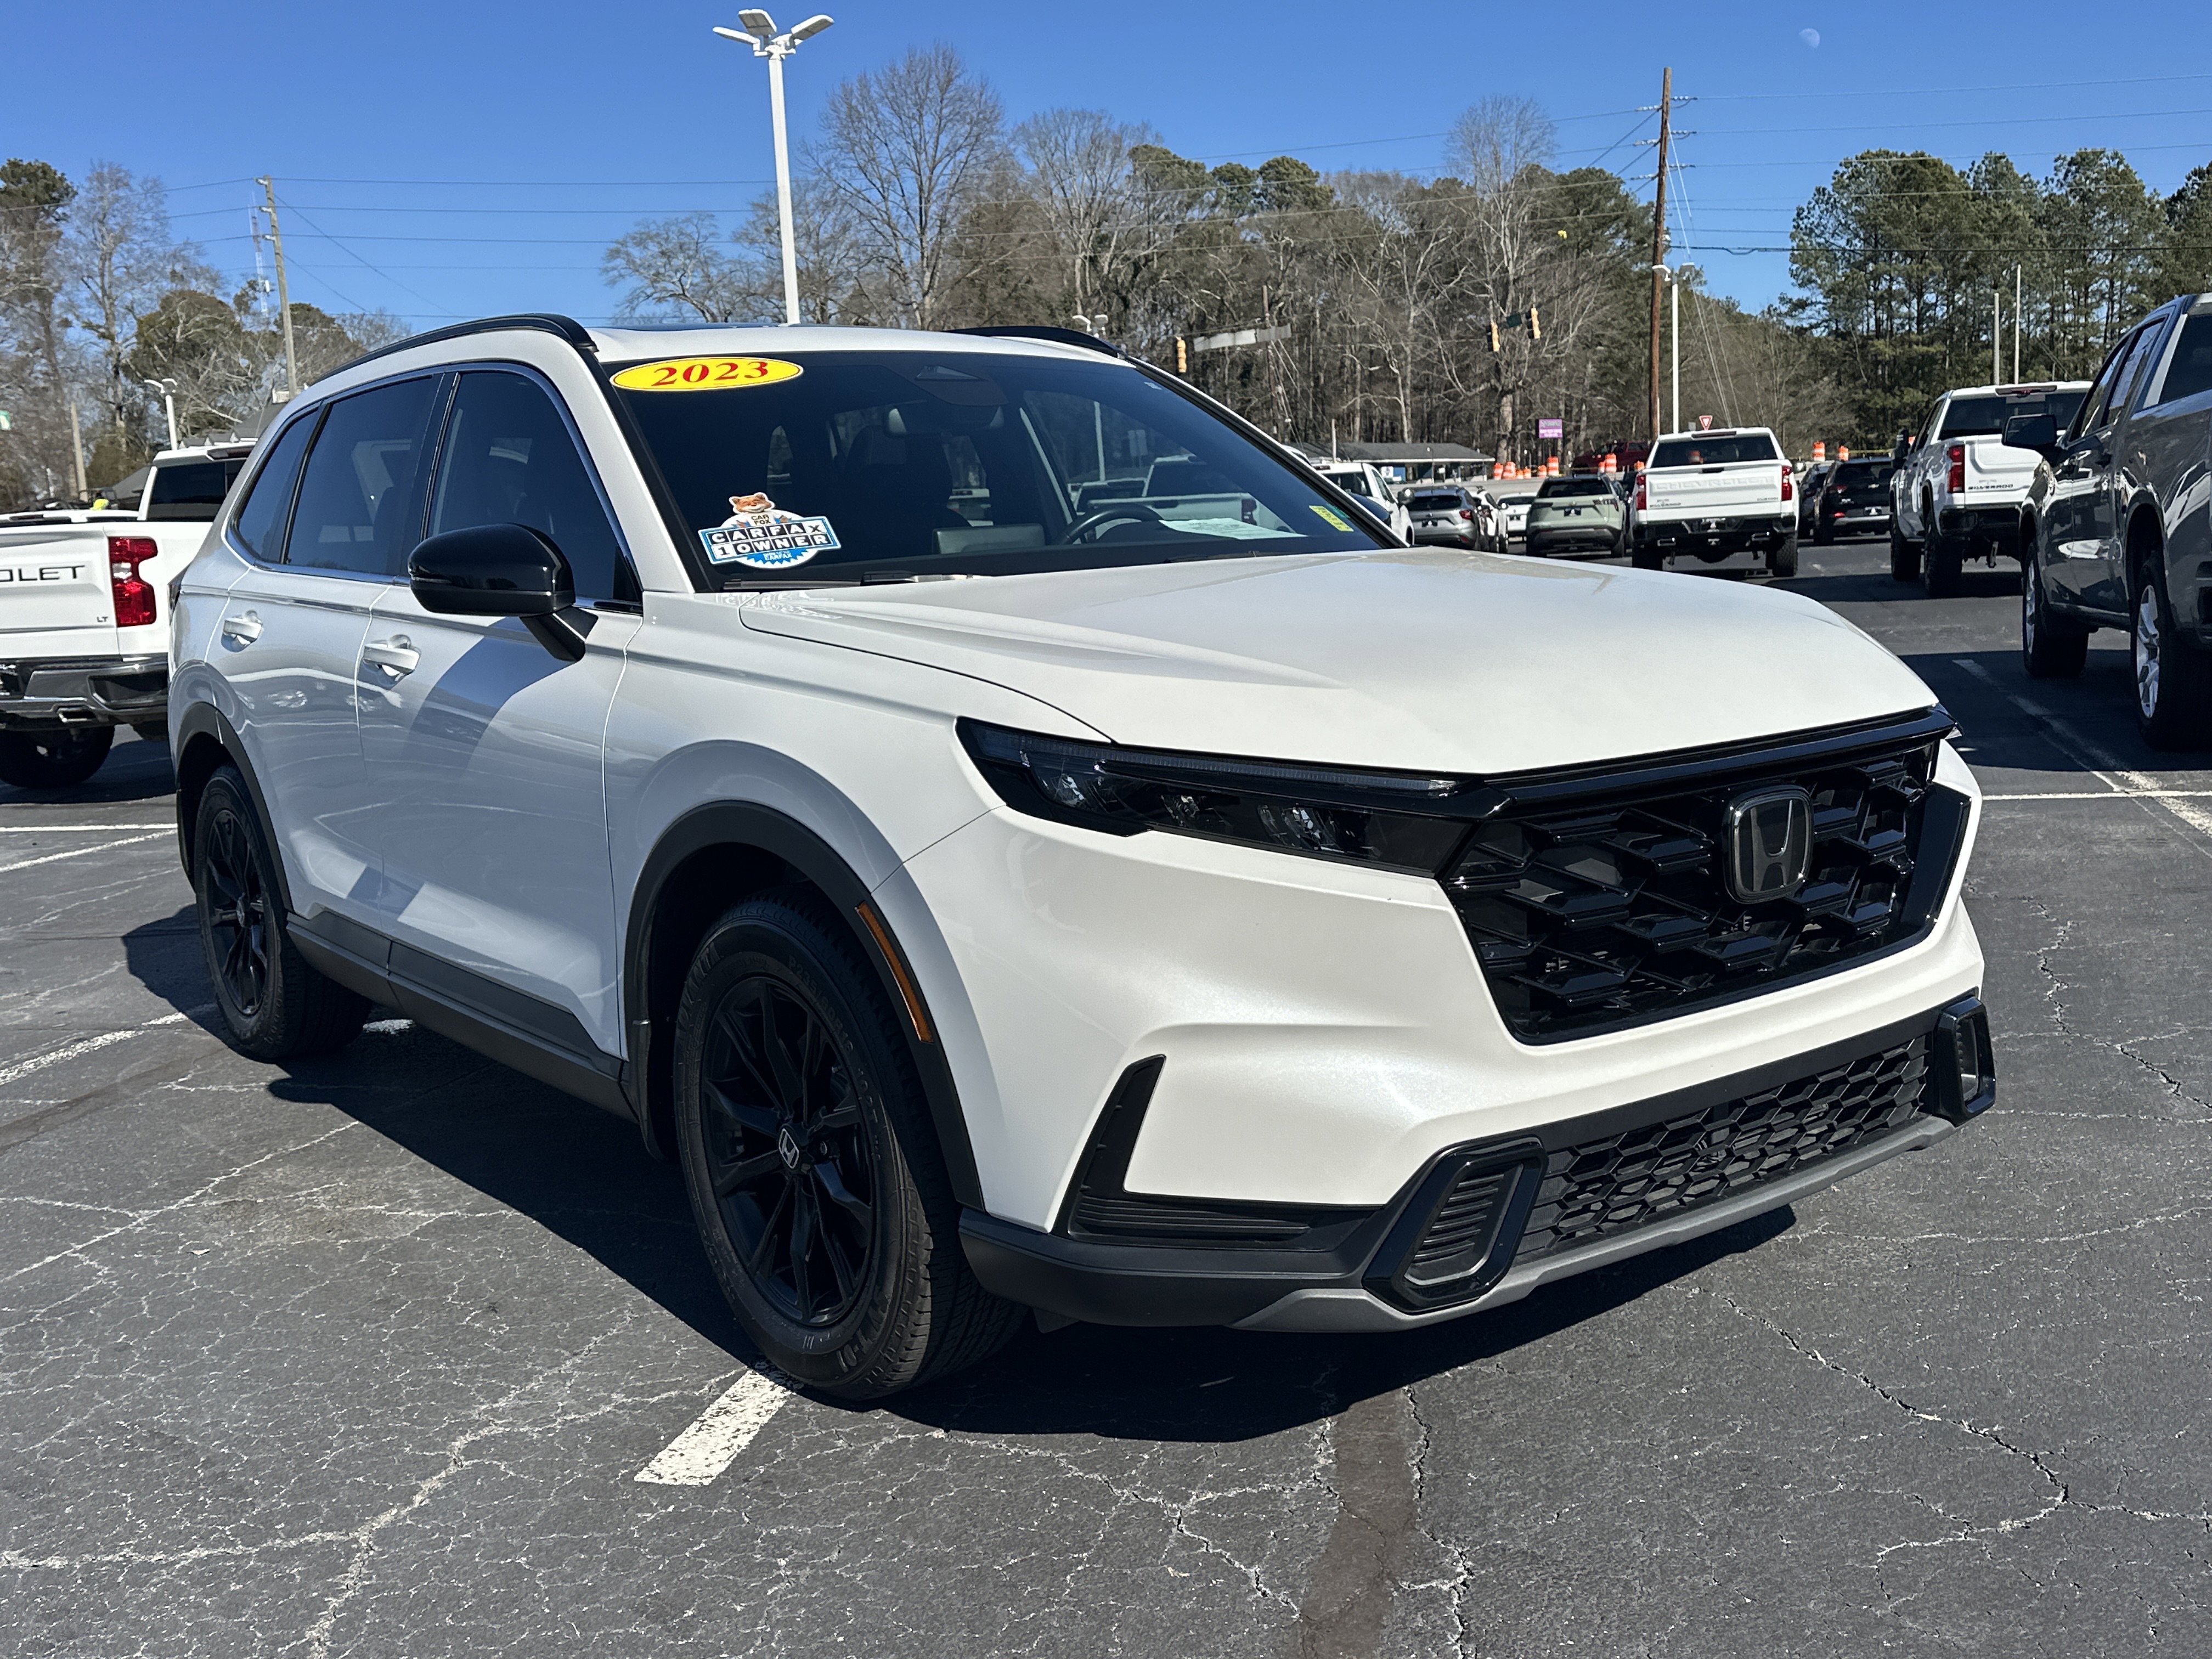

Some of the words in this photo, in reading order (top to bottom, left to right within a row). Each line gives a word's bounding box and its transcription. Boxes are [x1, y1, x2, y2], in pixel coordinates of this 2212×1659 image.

[651, 361, 768, 387] 2023
[712, 523, 822, 543] CARFAX
[717, 546, 730, 556] 1
[736, 534, 828, 553] OWNER
